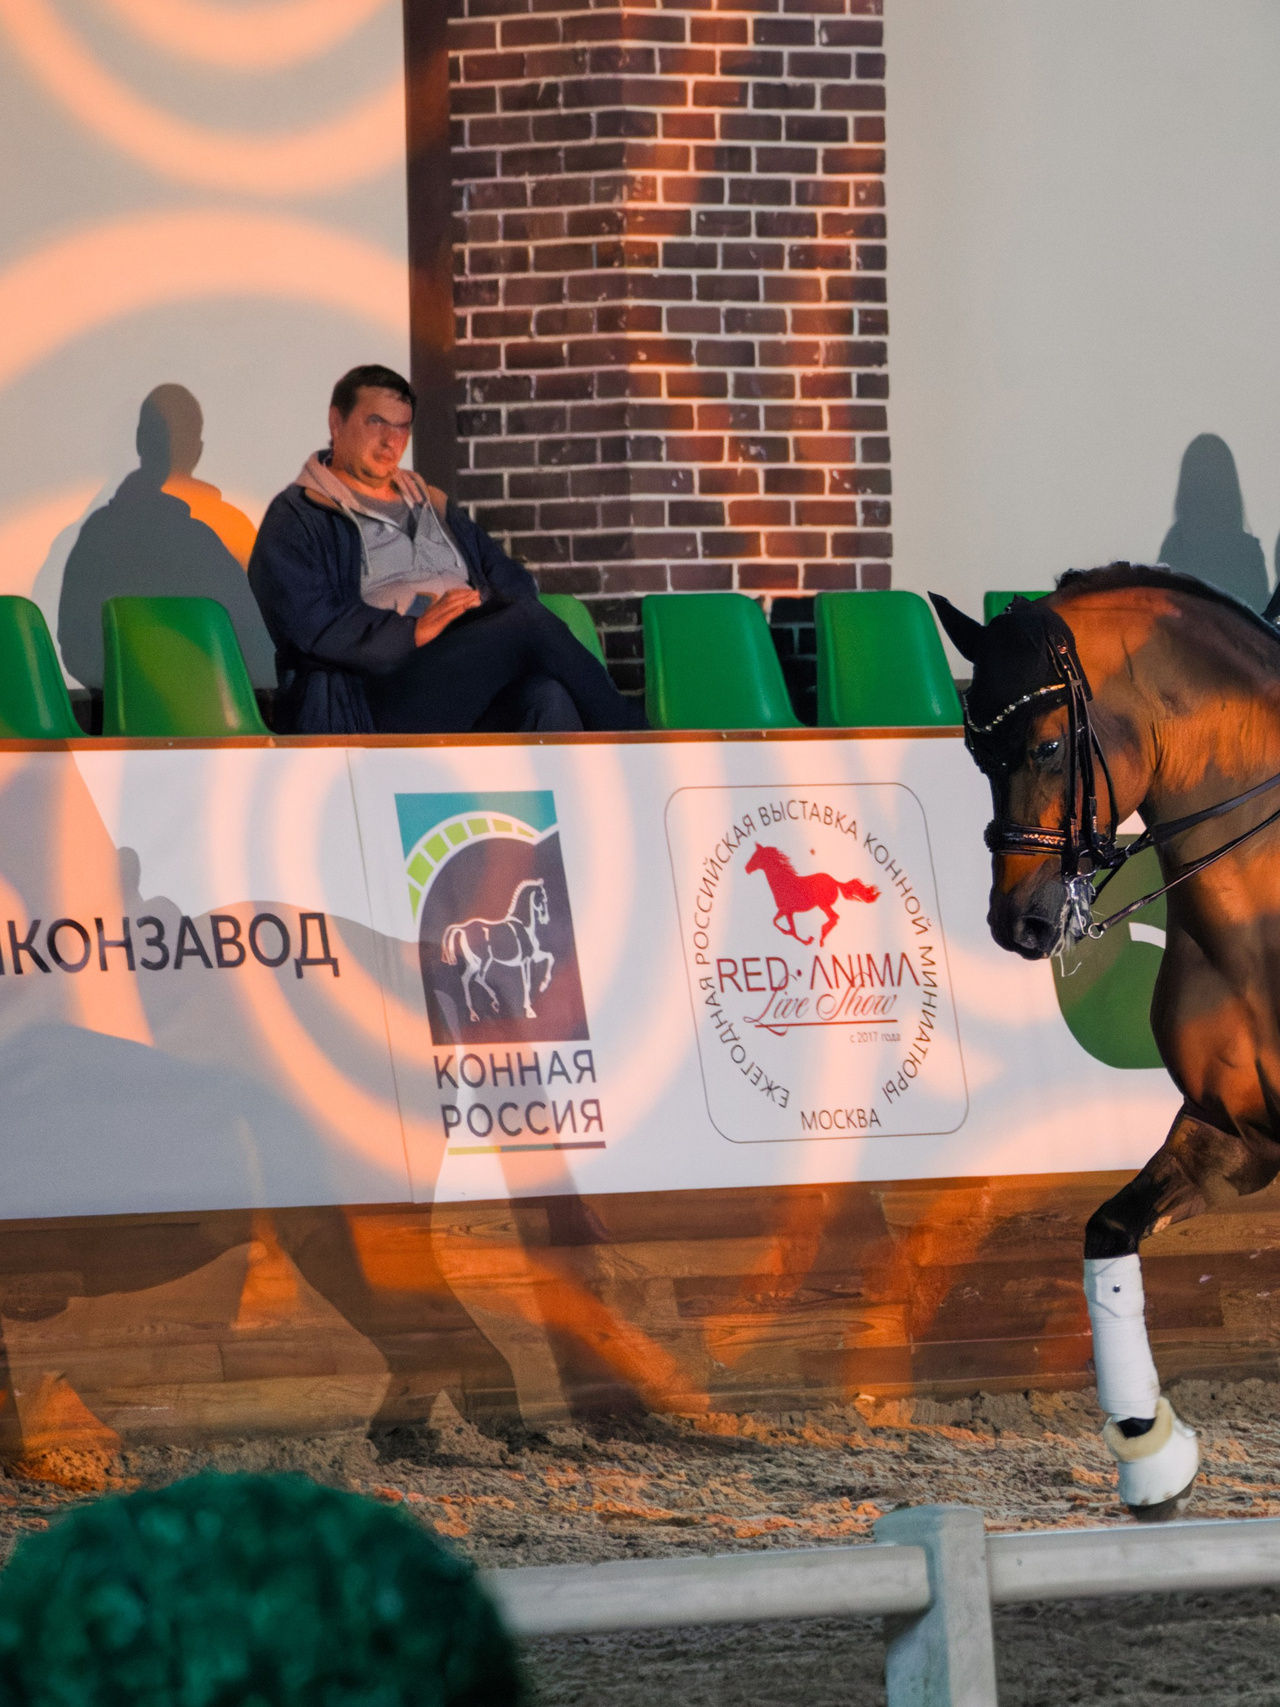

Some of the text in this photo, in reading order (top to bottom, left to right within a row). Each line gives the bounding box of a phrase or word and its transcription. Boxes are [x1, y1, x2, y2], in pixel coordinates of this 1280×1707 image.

[0, 912, 341, 979] КОНЗАВОД
[693, 799, 939, 1108] ЕЖЕГОДНАЯ РОССИЙСКАЯ ВЫСТАВКА КОННОЙ МИНИАТЮРЫ
[716, 956, 790, 993] RED
[743, 972, 898, 1036] Live Show
[432, 1049, 597, 1090] КОННАЯ
[440, 1098, 605, 1139] РОССИЯ
[800, 1108, 882, 1131] МОСКВА
